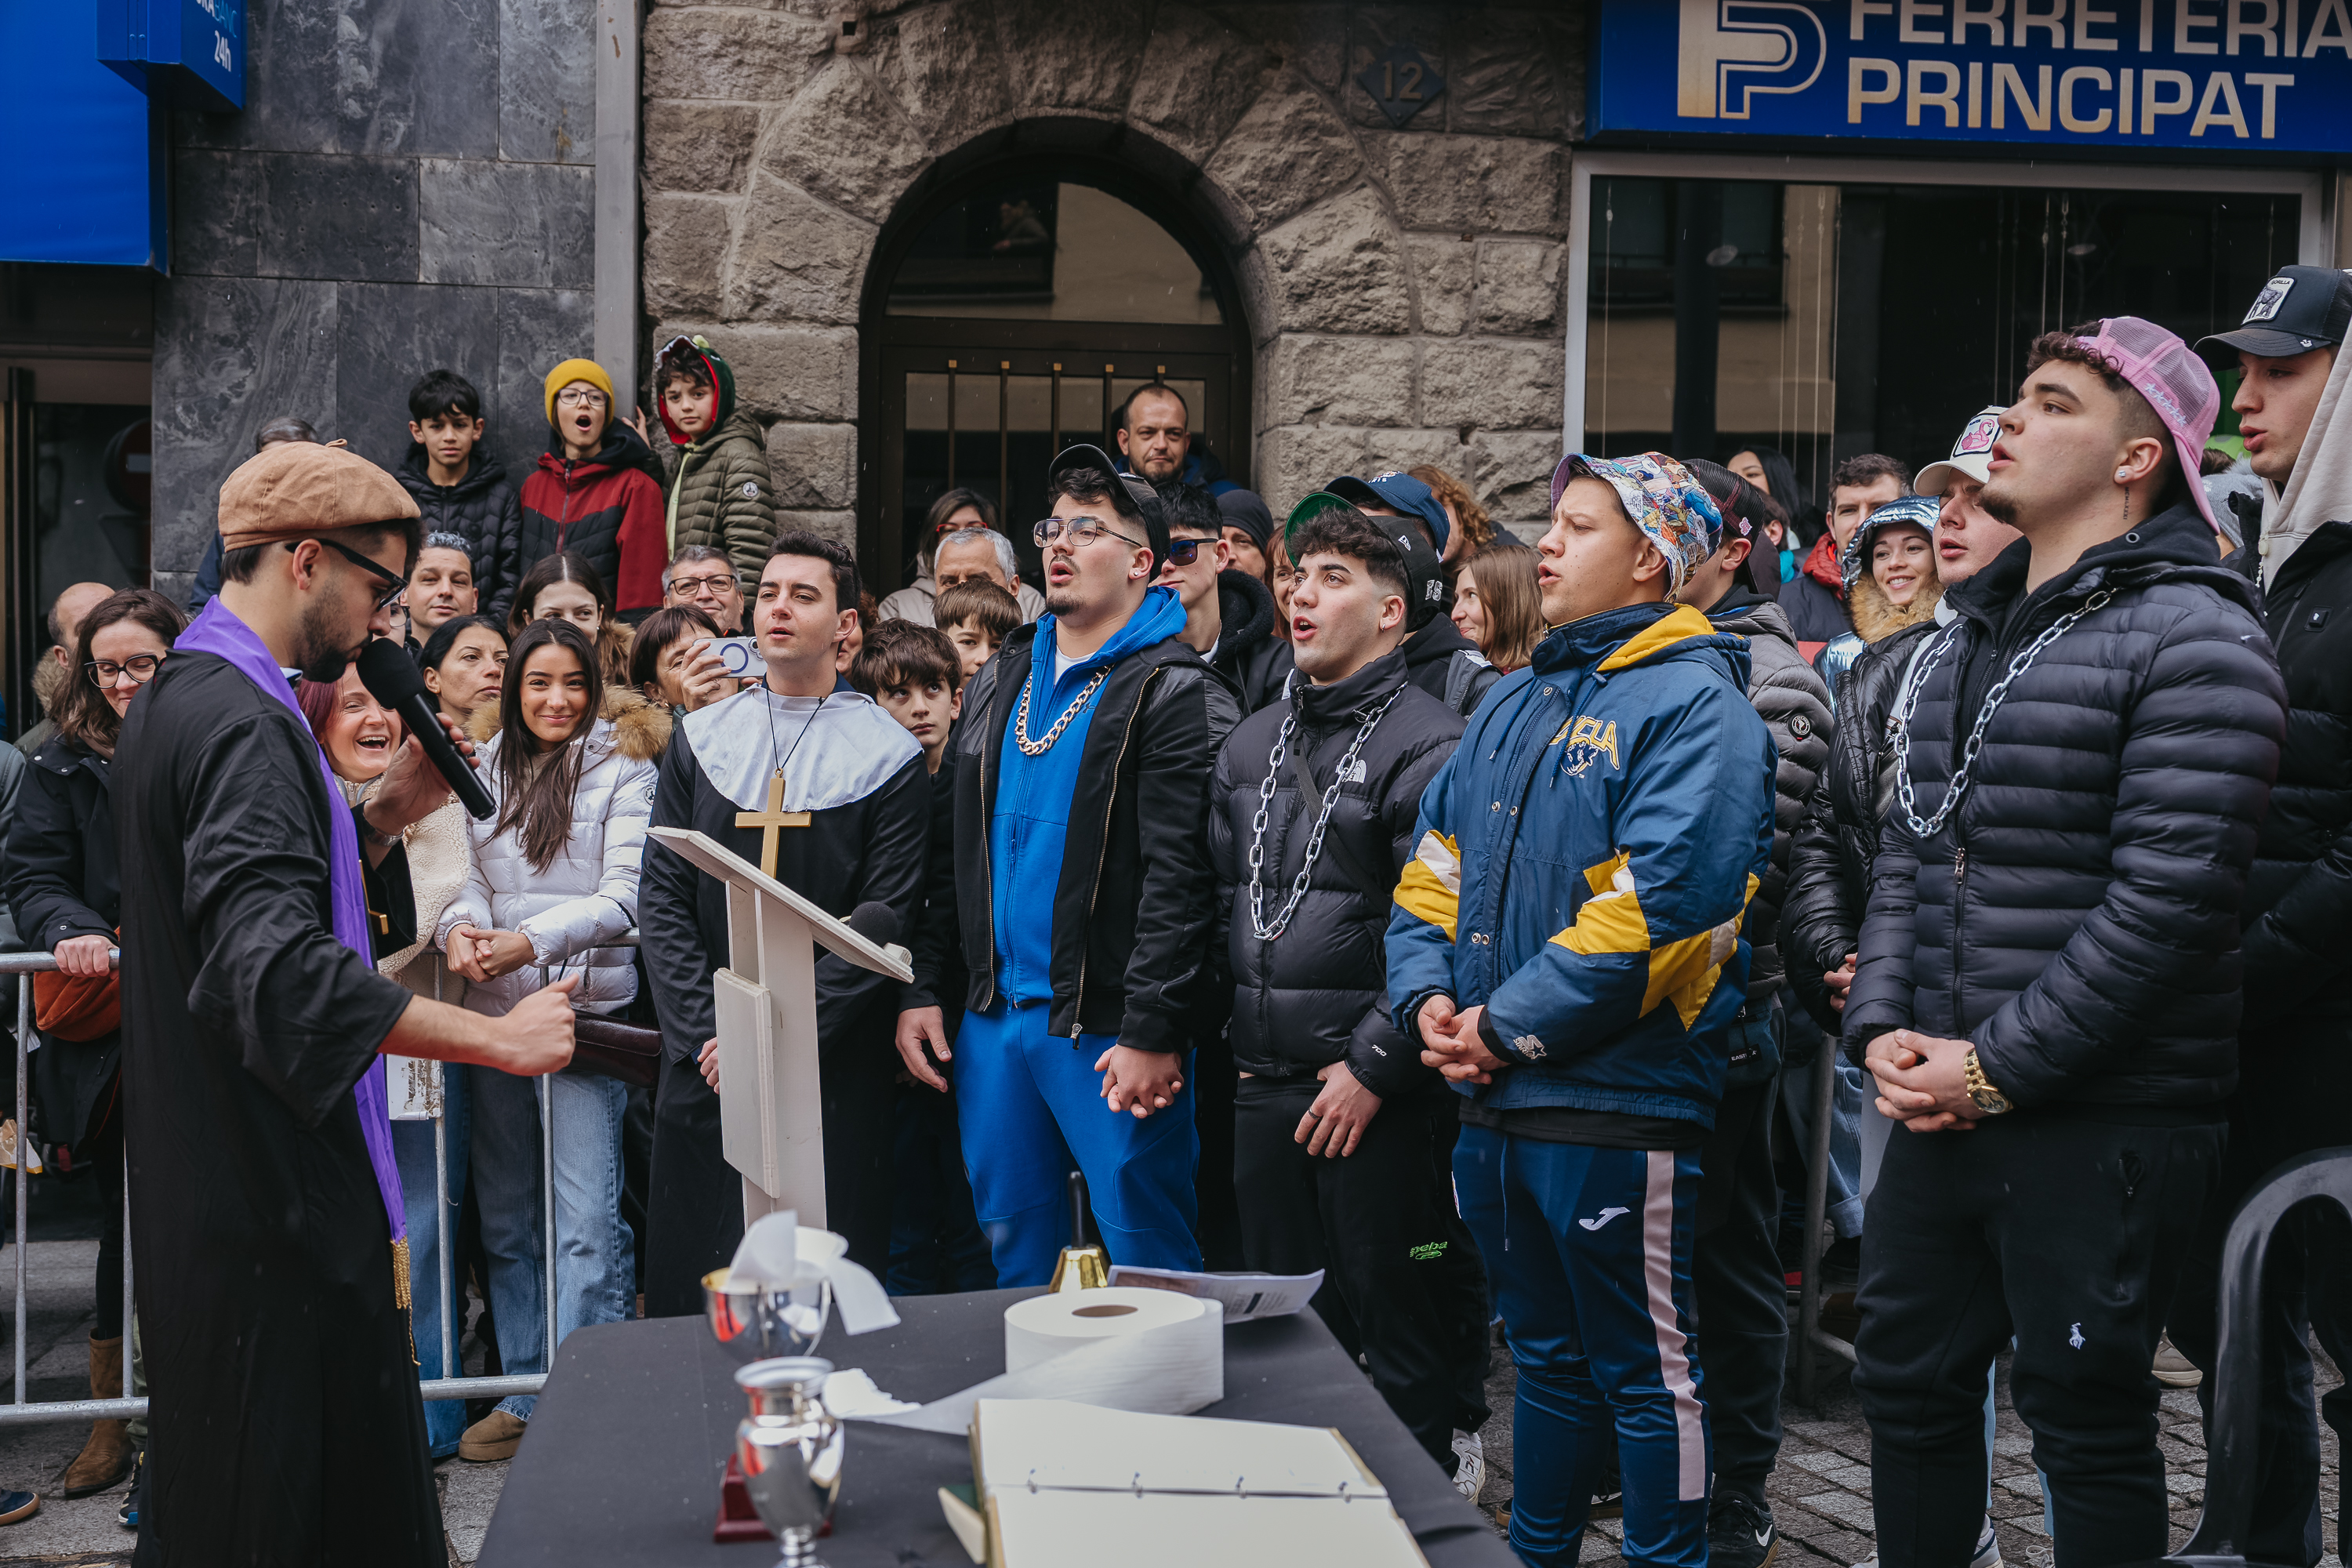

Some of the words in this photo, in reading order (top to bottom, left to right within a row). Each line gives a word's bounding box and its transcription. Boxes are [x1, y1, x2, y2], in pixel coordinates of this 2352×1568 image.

[1849, 0, 2352, 60] FERRETERIA
[214, 30, 232, 72] 24h
[1382, 60, 1423, 100] 12
[1847, 56, 2296, 140] PRINCIPAT
[1371, 1044, 1387, 1057] 700
[1731, 1050, 1757, 1061] EASTK
